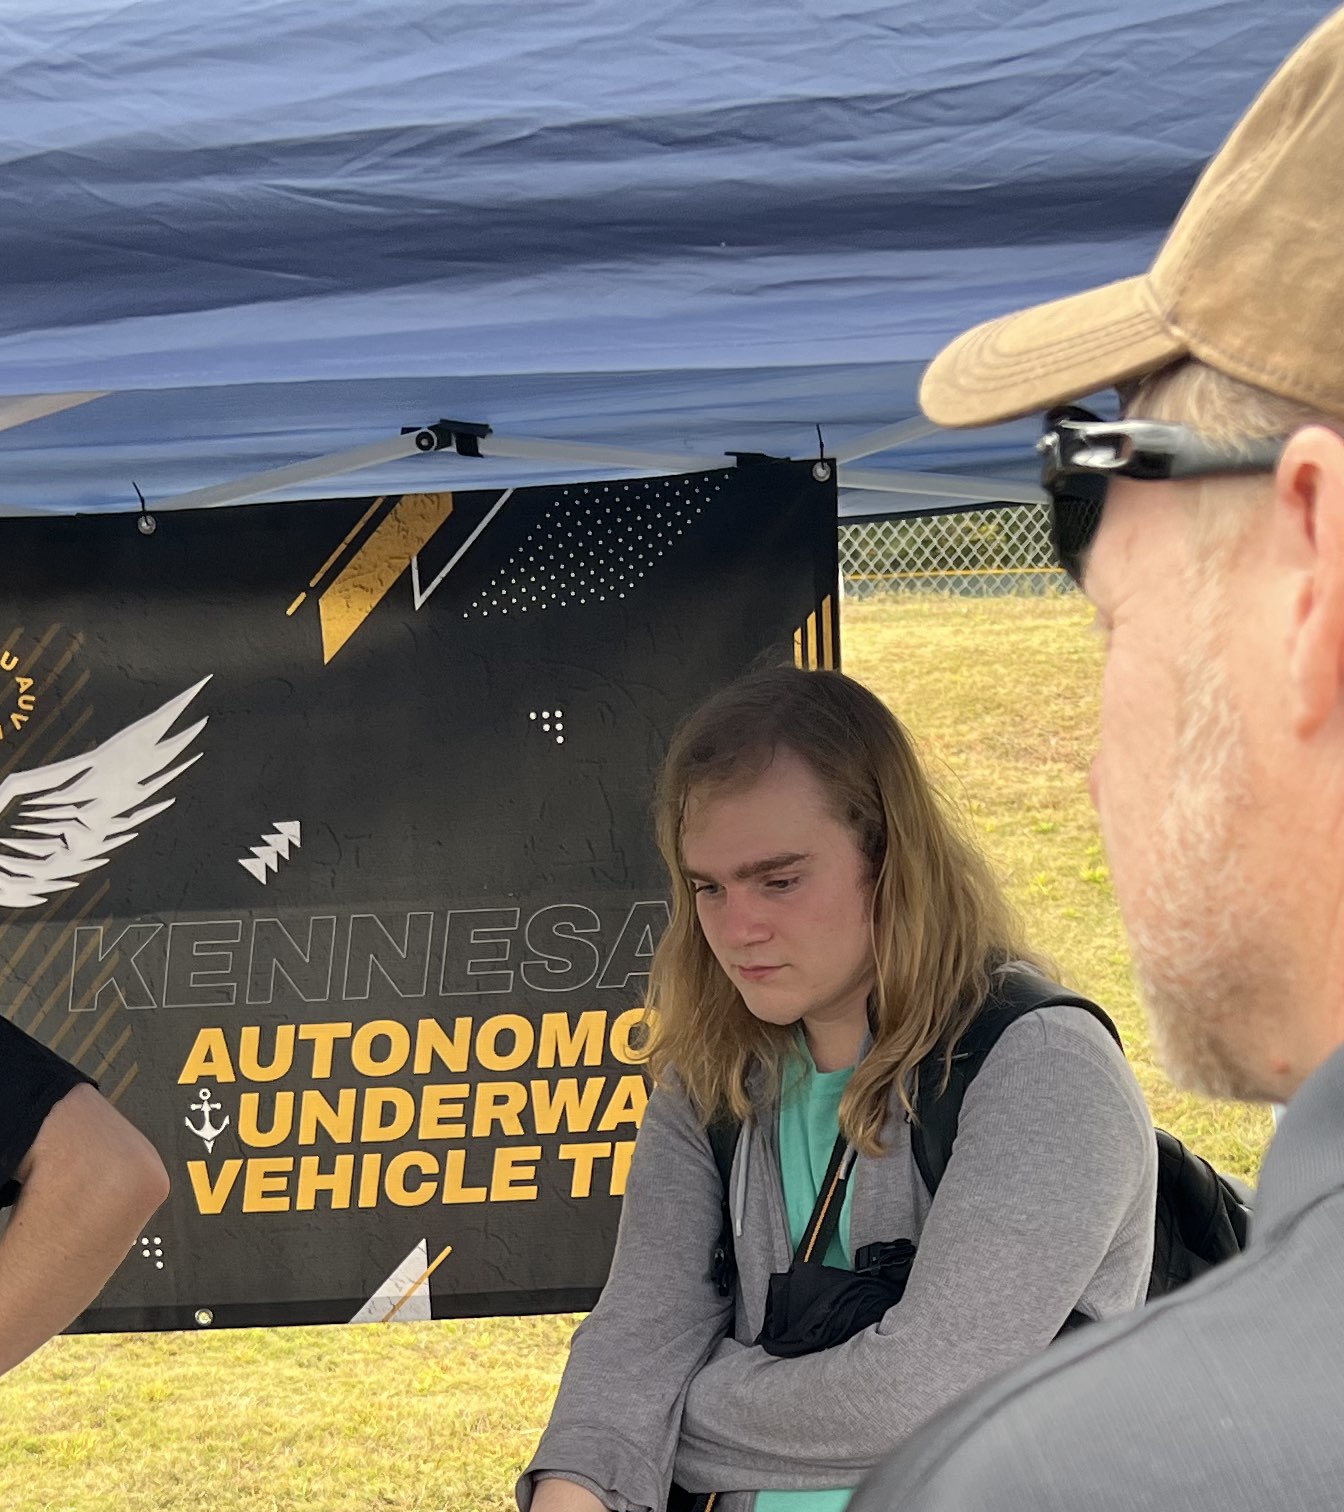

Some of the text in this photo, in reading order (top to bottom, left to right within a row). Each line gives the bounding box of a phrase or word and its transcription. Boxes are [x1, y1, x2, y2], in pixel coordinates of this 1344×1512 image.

[10, 676, 36, 731] AUV
[68, 900, 673, 1012] KENNESA
[177, 1007, 664, 1085] AUTONOMO
[237, 1074, 650, 1149] UNDERWA
[186, 1144, 543, 1215] VEHICLE
